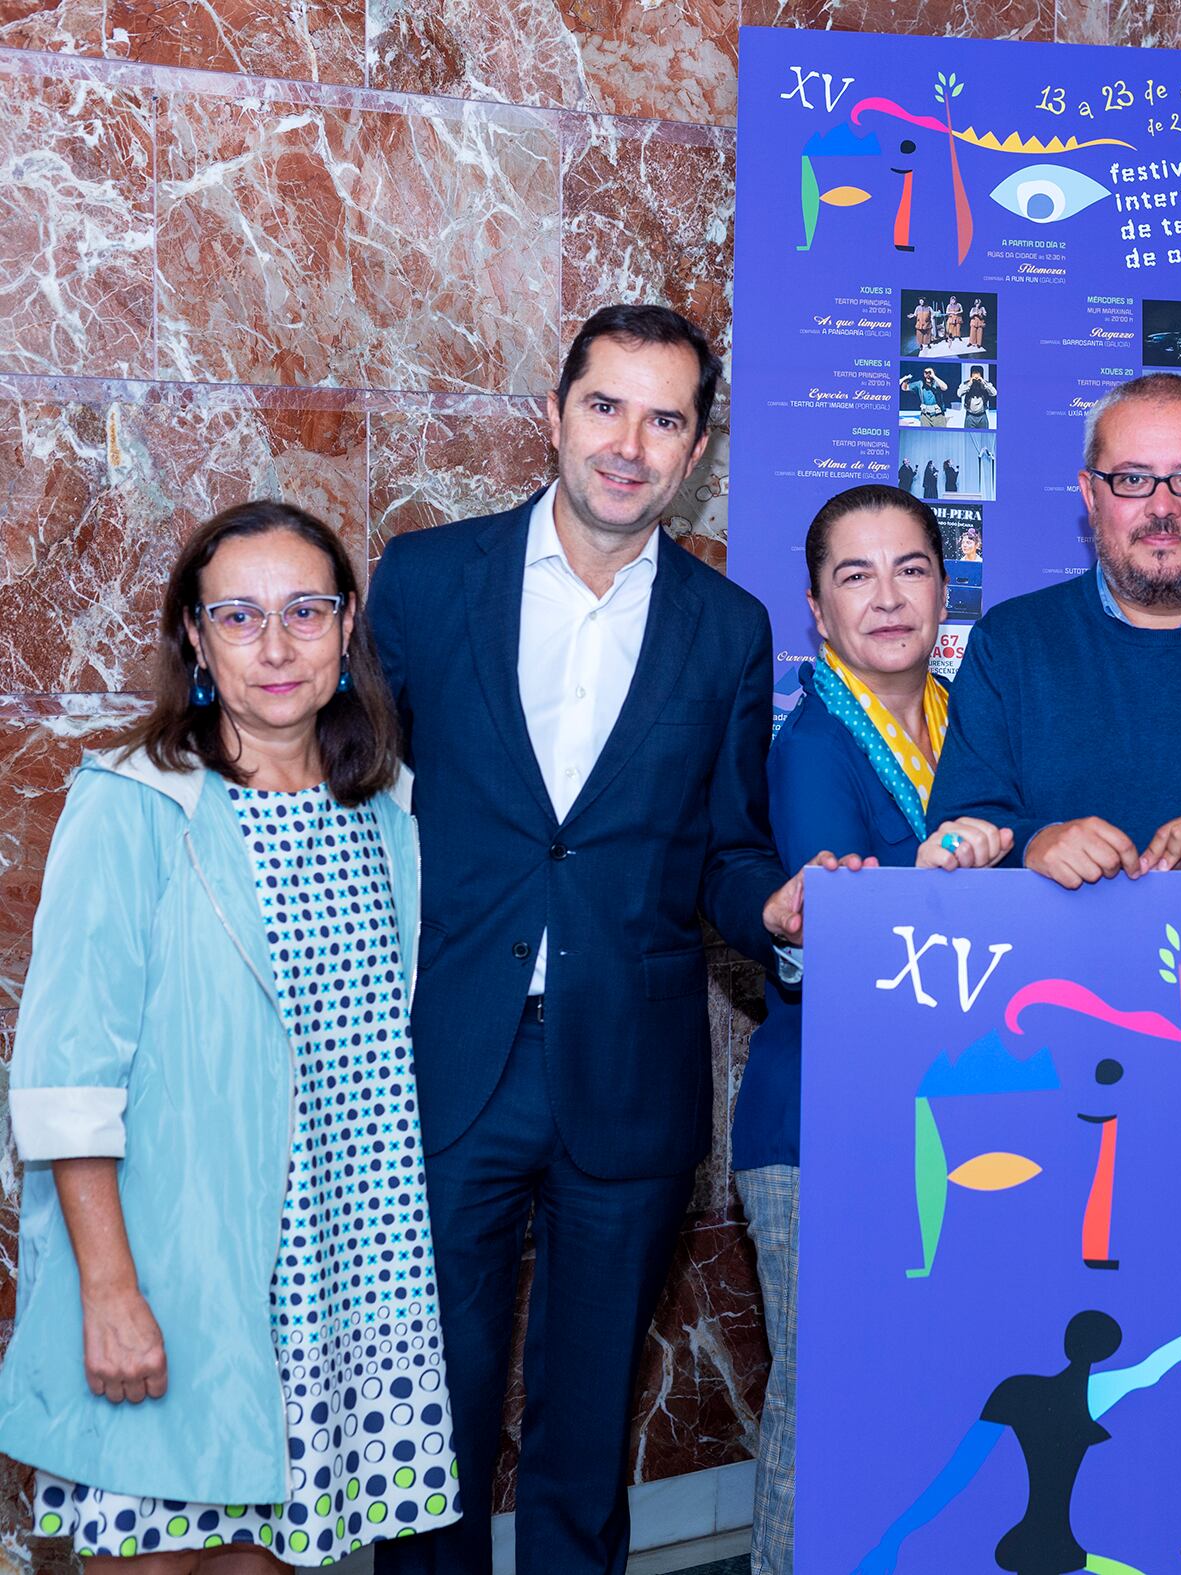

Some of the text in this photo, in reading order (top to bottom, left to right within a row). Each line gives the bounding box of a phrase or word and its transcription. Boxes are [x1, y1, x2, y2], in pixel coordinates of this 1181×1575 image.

[779, 65, 855, 113] XV
[1036, 85, 1066, 113] 13
[1078, 100, 1095, 119] a
[1100, 80, 1136, 114] 23
[1144, 79, 1168, 102] de
[1146, 117, 1165, 137] de
[1120, 215, 1152, 241] de
[1009, 240, 1034, 248] PARTIR
[1035, 240, 1045, 248] DO
[1046, 240, 1058, 249] DÍA
[1015, 252, 1038, 260] CIDADE
[1125, 245, 1157, 270] de
[1011, 275, 1025, 283] RUN
[1039, 276, 1067, 285] (GALICIA)
[860, 286, 892, 295] XOVES 13
[859, 299, 892, 307] PRINCIPAL
[1087, 295, 1125, 305] MÉRCORES
[1087, 307, 1134, 316] MUR MARXINAL
[813, 314, 892, 329] As que limpan
[828, 328, 864, 336] PANADARÍA
[864, 330, 892, 338] (GALICIA)
[1089, 326, 1135, 341] Ragazzo
[1062, 338, 1104, 347] BARROSANTA
[854, 359, 891, 368] VENRES 14
[833, 370, 891, 380] TEATRO PRINCIPAL
[1100, 367, 1134, 376] XOVES 20
[1077, 379, 1101, 387] TEATRO
[808, 387, 892, 402] Especies Lázaro
[790, 400, 814, 408] TEATRO
[855, 402, 891, 411] (PORTUGAL)
[852, 427, 890, 437] SÁBADO 15
[832, 439, 890, 449] TEATRO PRINCIPAL
[813, 457, 848, 469] Alma
[850, 460, 865, 470] de
[797, 470, 829, 478] ELEFANTE
[829, 471, 862, 479] ELEGANTE
[862, 472, 890, 481] (GALICIA)
[941, 634, 959, 647] 67
[875, 925, 1012, 1013] XV
